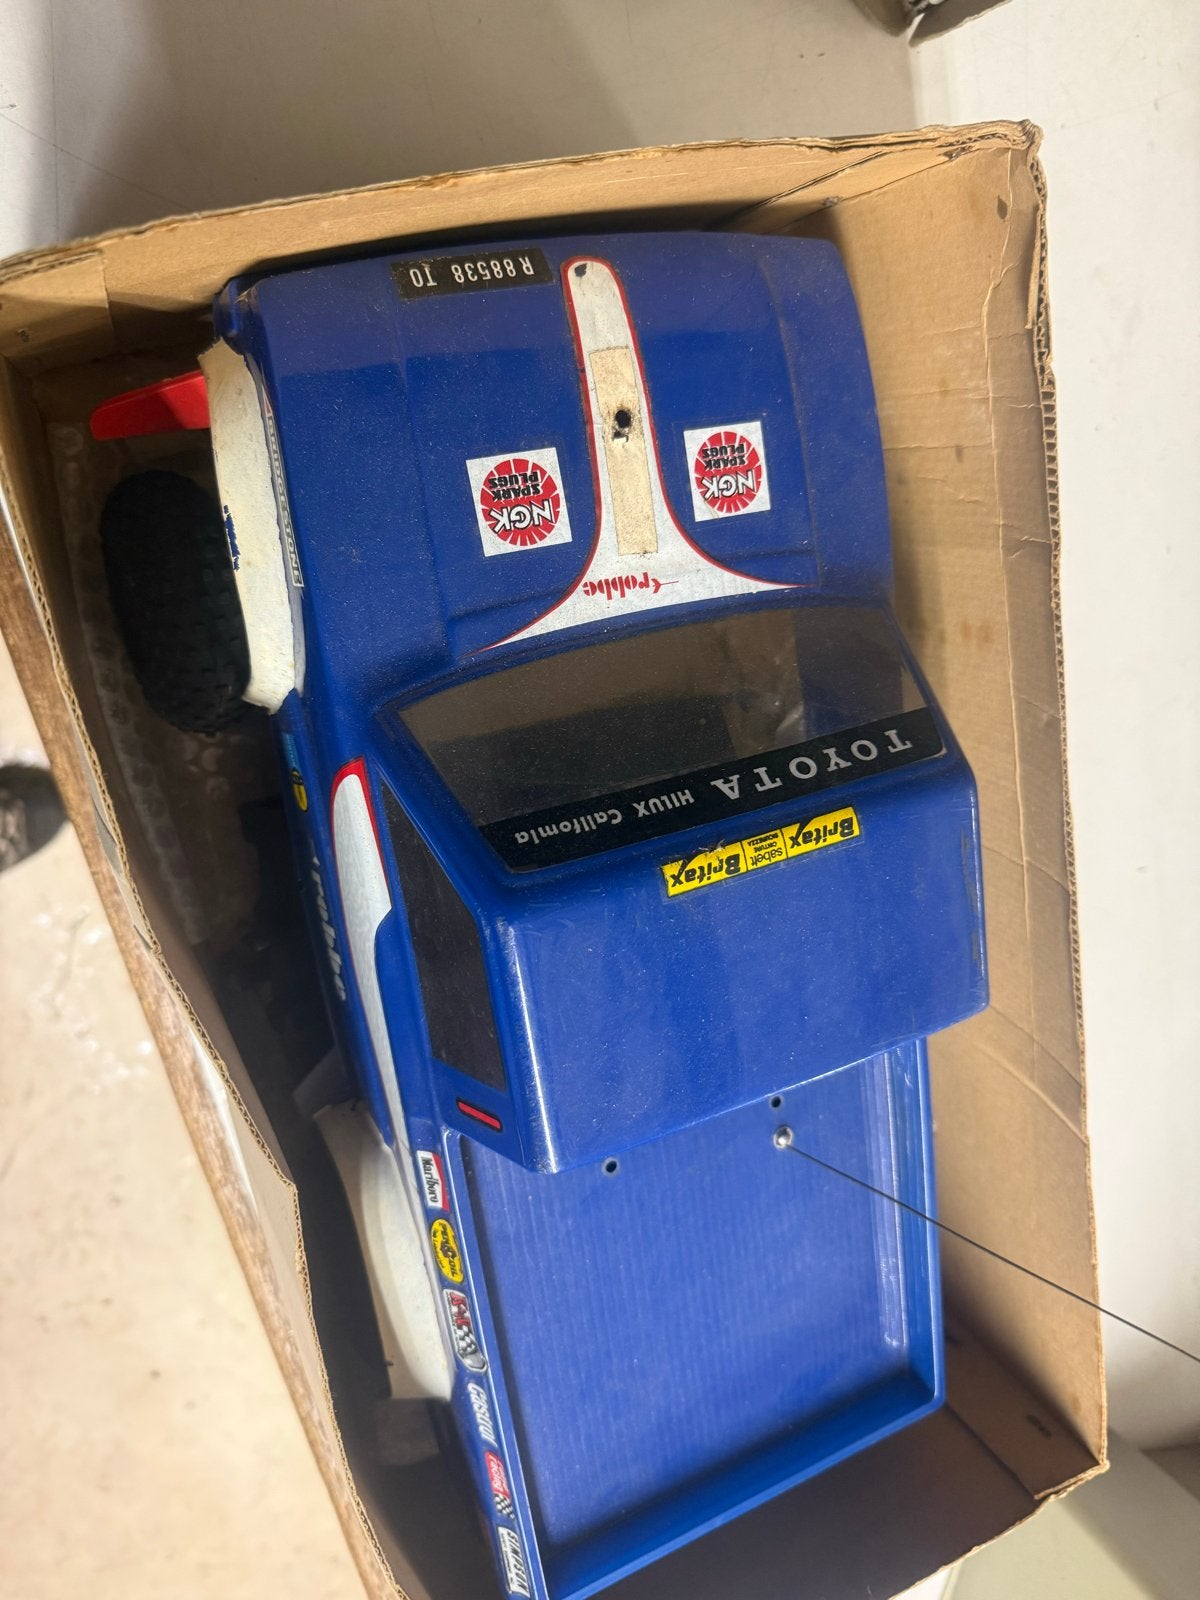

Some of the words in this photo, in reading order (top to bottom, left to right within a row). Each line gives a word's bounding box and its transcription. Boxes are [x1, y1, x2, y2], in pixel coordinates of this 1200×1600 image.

[409, 267, 437, 287] TO
[702, 444, 745, 458] PLUGS
[704, 456, 745, 470] SPARK
[488, 471, 539, 487] PLUGS
[491, 484, 541, 501] SPARK
[701, 470, 756, 500] NGK
[488, 499, 554, 534] NGK
[582, 572, 650, 600] robbe
[710, 728, 913, 801] TOYOTA
[631, 788, 695, 818] HILUX
[789, 817, 854, 849] Britax
[670, 852, 741, 888] Britax
[749, 848, 783, 867] sabelt
[421, 1156, 439, 1203] Marlboro
[467, 1382, 498, 1447] Castrol
[507, 1533, 528, 1590] SIMPSON
